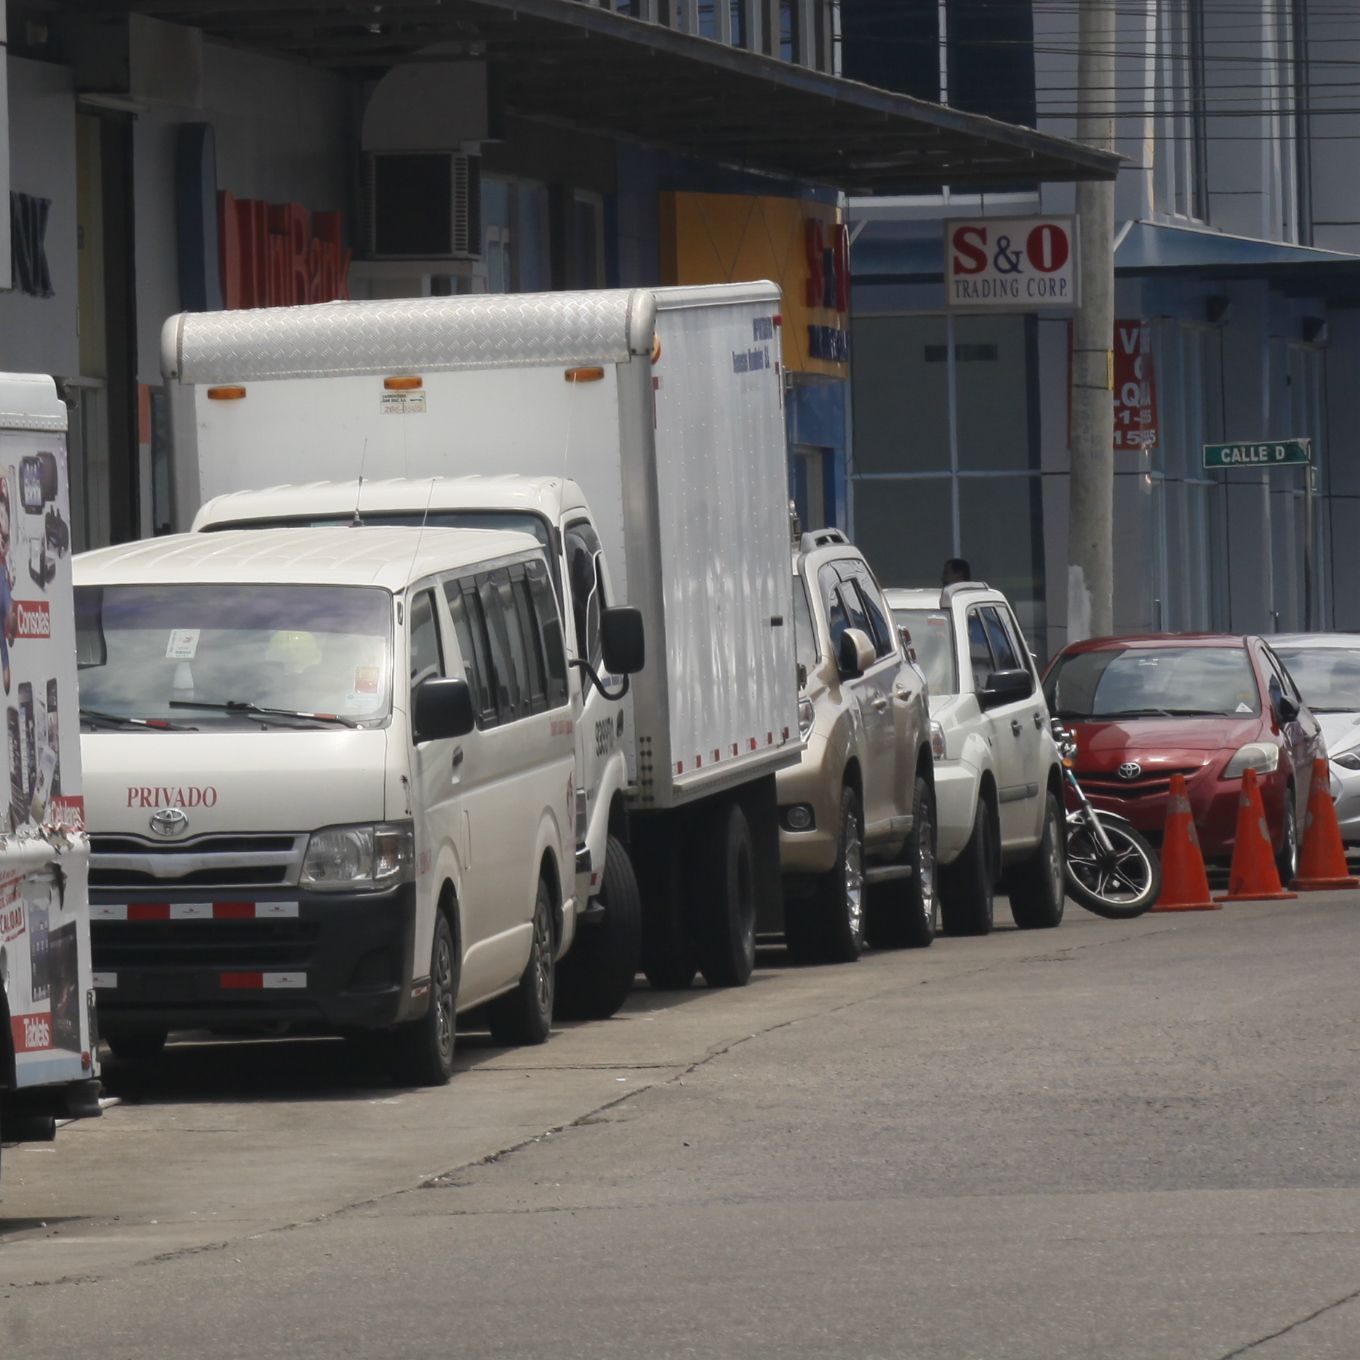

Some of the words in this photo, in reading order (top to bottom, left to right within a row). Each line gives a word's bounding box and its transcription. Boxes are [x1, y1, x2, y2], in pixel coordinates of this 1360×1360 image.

[953, 277, 1020, 299] TRADING
[1220, 445, 1269, 463] CALLE
[1275, 445, 1286, 461] D
[17, 603, 51, 636] Consolas
[126, 785, 218, 809] PRIVADO
[23, 1017, 51, 1048] Tablets
